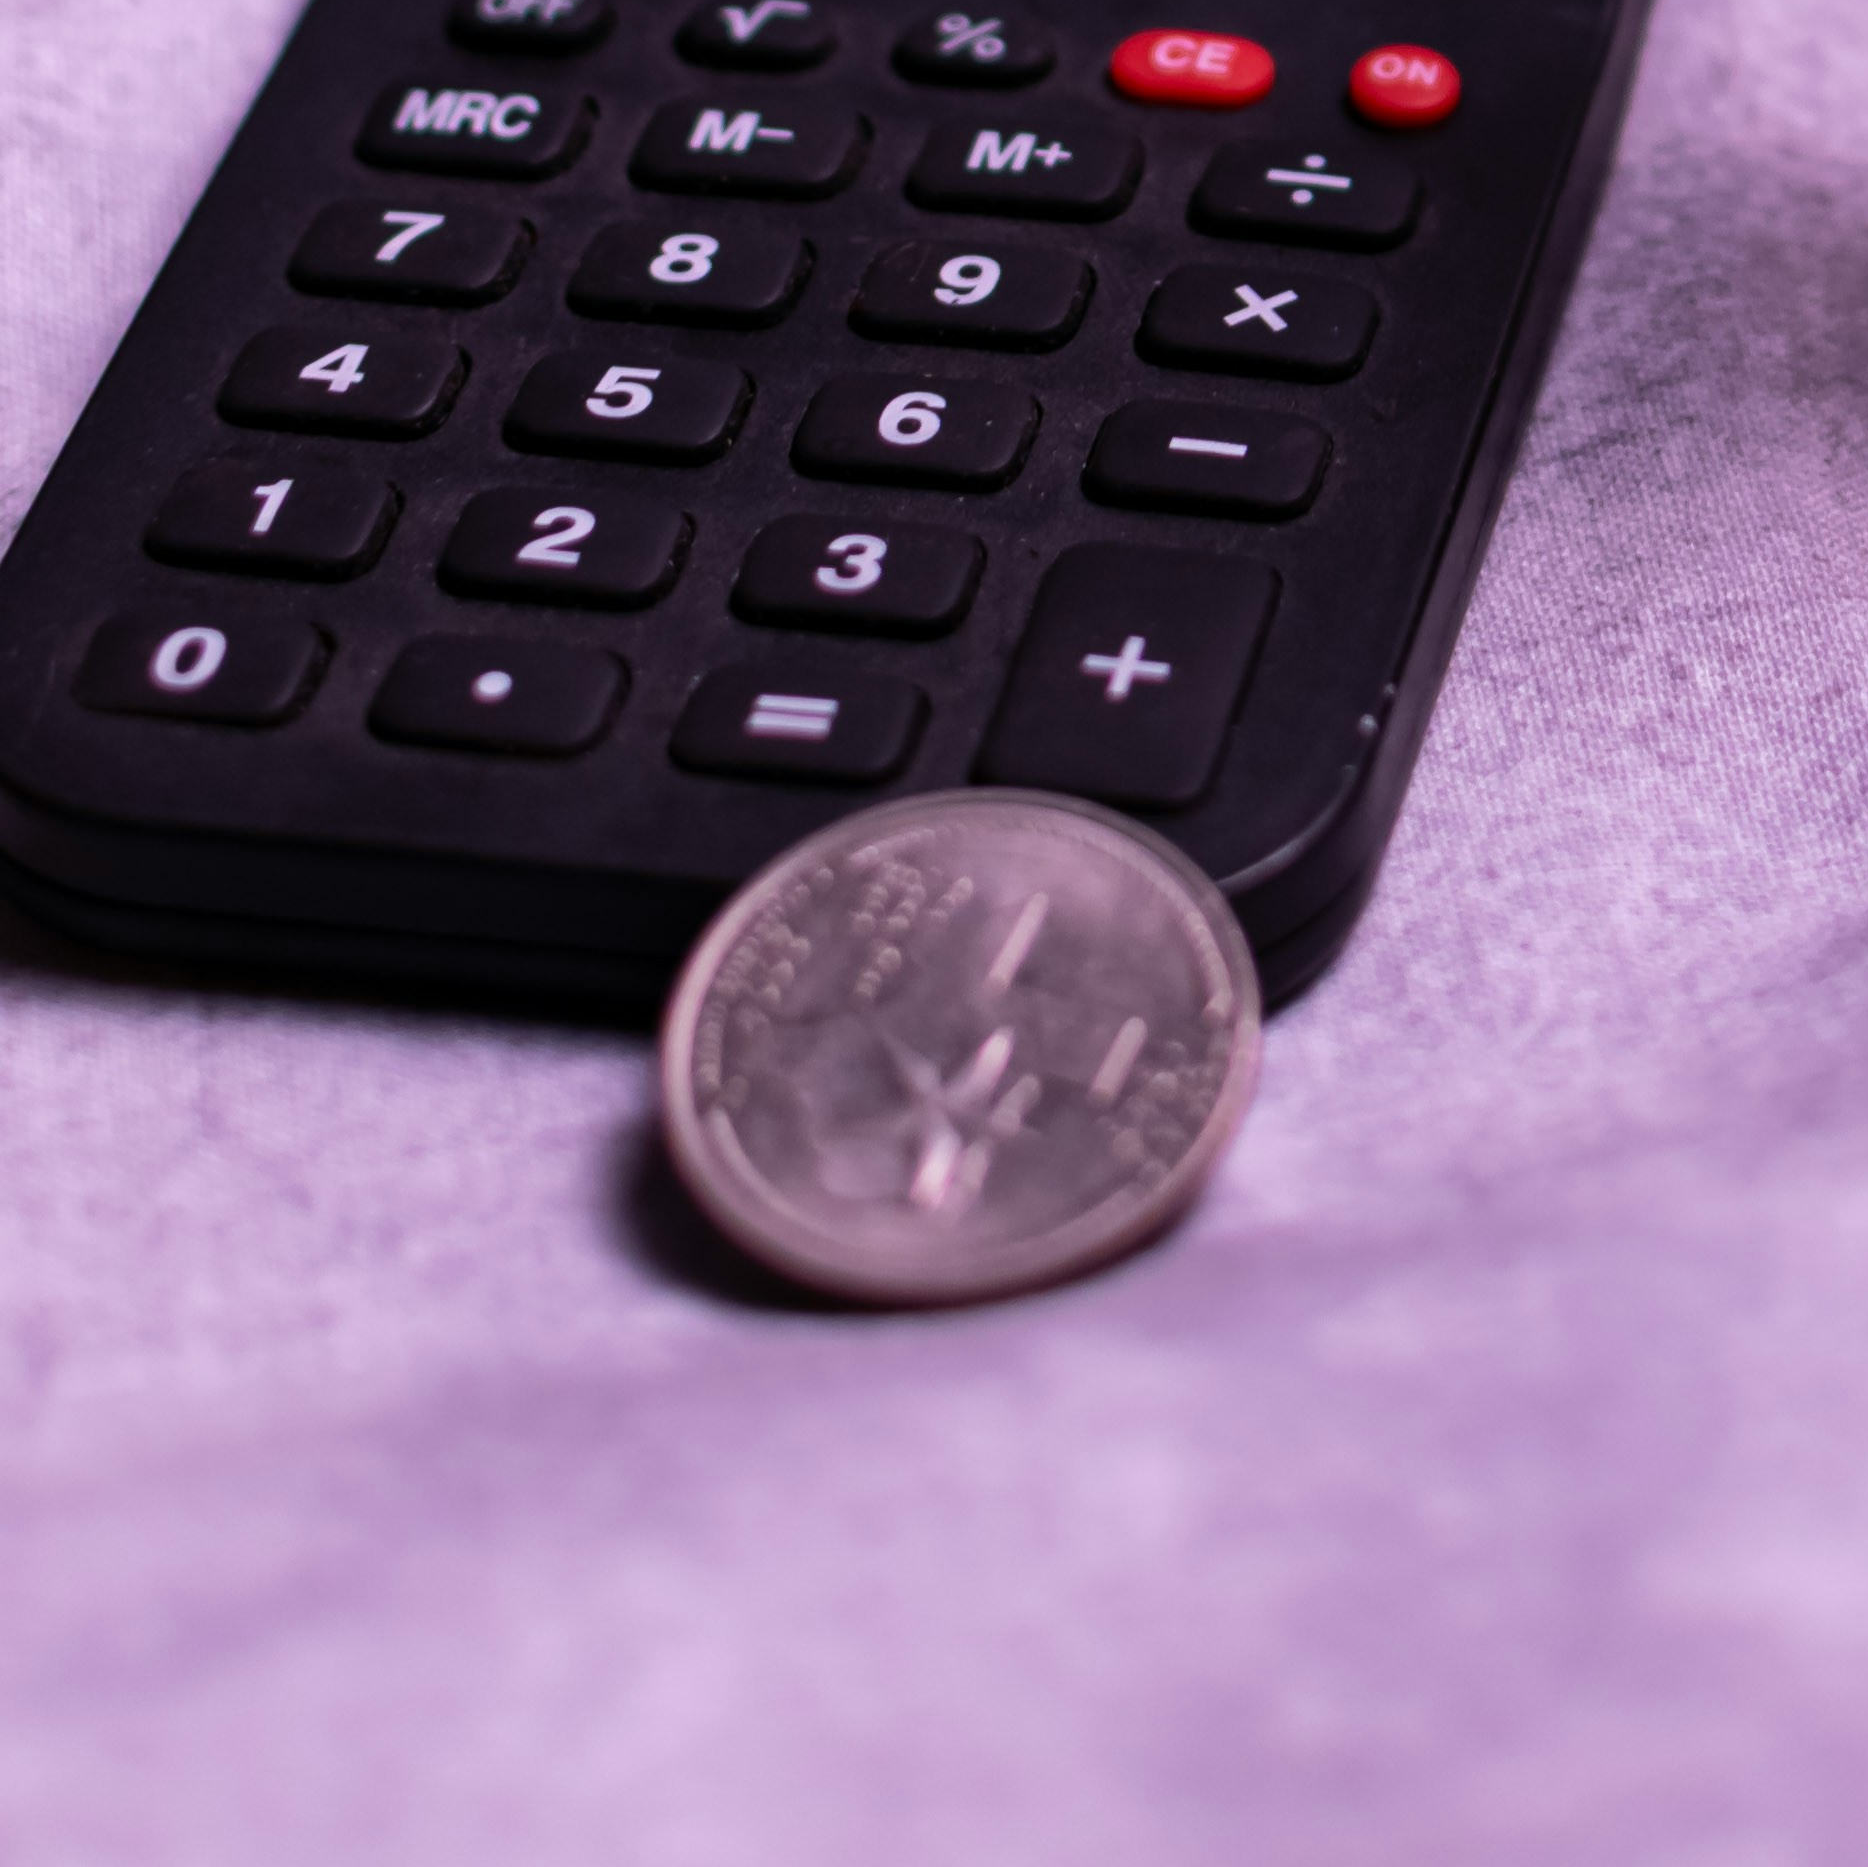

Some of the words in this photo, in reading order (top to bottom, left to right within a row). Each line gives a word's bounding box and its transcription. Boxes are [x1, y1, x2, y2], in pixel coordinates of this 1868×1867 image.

[1149, 34, 1237, 80] CE
[1366, 52, 1441, 91] ON
[393, 88, 541, 140] MRC
[965, 129, 1074, 173] M+
[374, 209, 446, 263] 7
[648, 232, 720, 284] 8
[932, 254, 1002, 307] 9
[297, 342, 370, 394] 4
[584, 364, 663, 419] 5
[877, 390, 948, 447] 6
[251, 477, 295, 534] 1
[516, 505, 597, 566] 2
[815, 533, 889, 592] 3
[151, 625, 228, 690] 0
